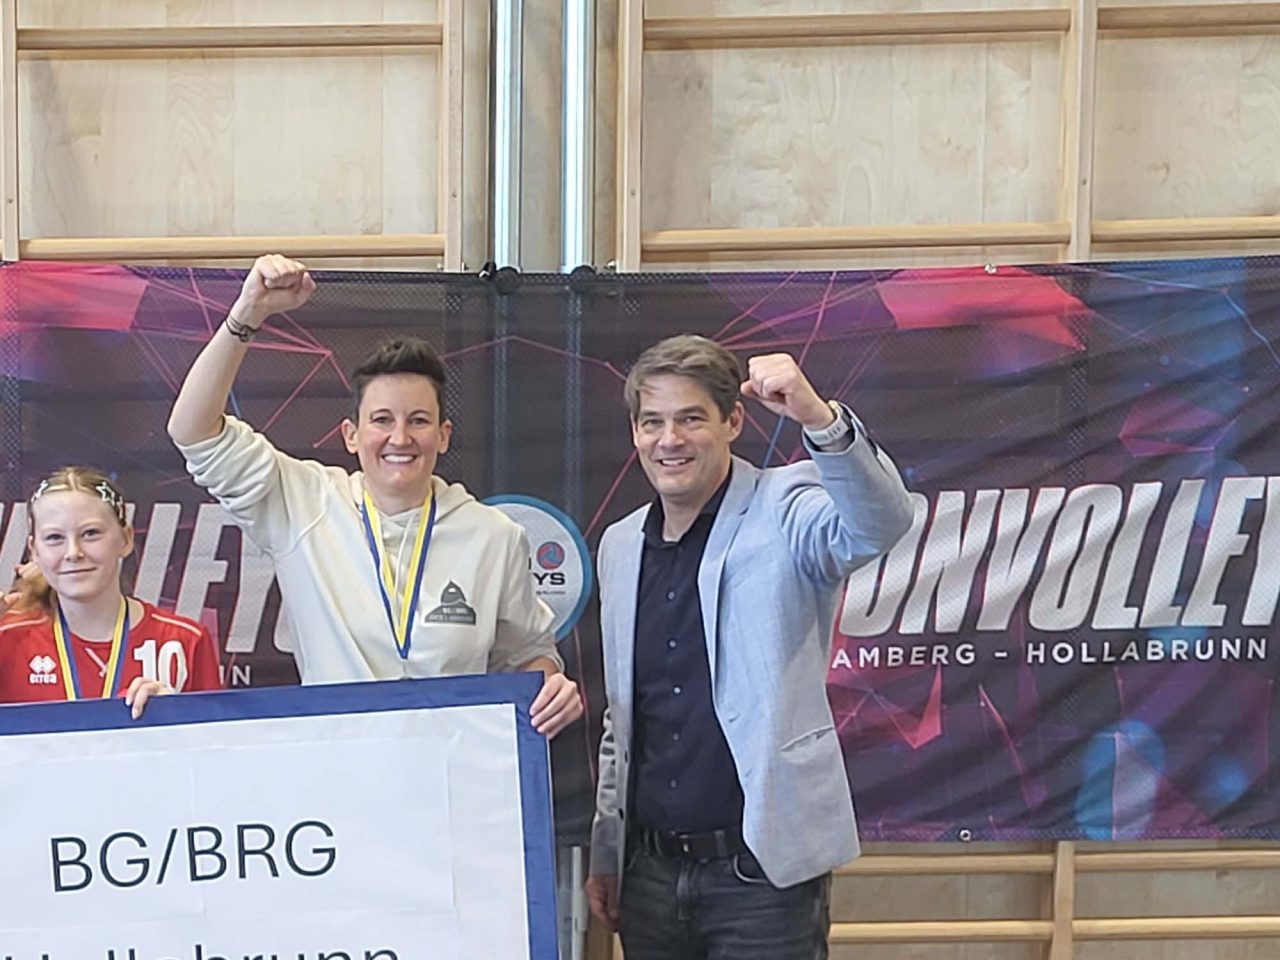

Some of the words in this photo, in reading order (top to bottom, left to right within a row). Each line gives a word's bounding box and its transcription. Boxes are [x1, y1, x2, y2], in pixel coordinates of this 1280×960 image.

[133, 639, 188, 693] 10
[831, 643, 976, 669] AMBERG
[1026, 637, 1267, 664] HOLLABRUNN
[50, 819, 337, 893] BG/BRG
